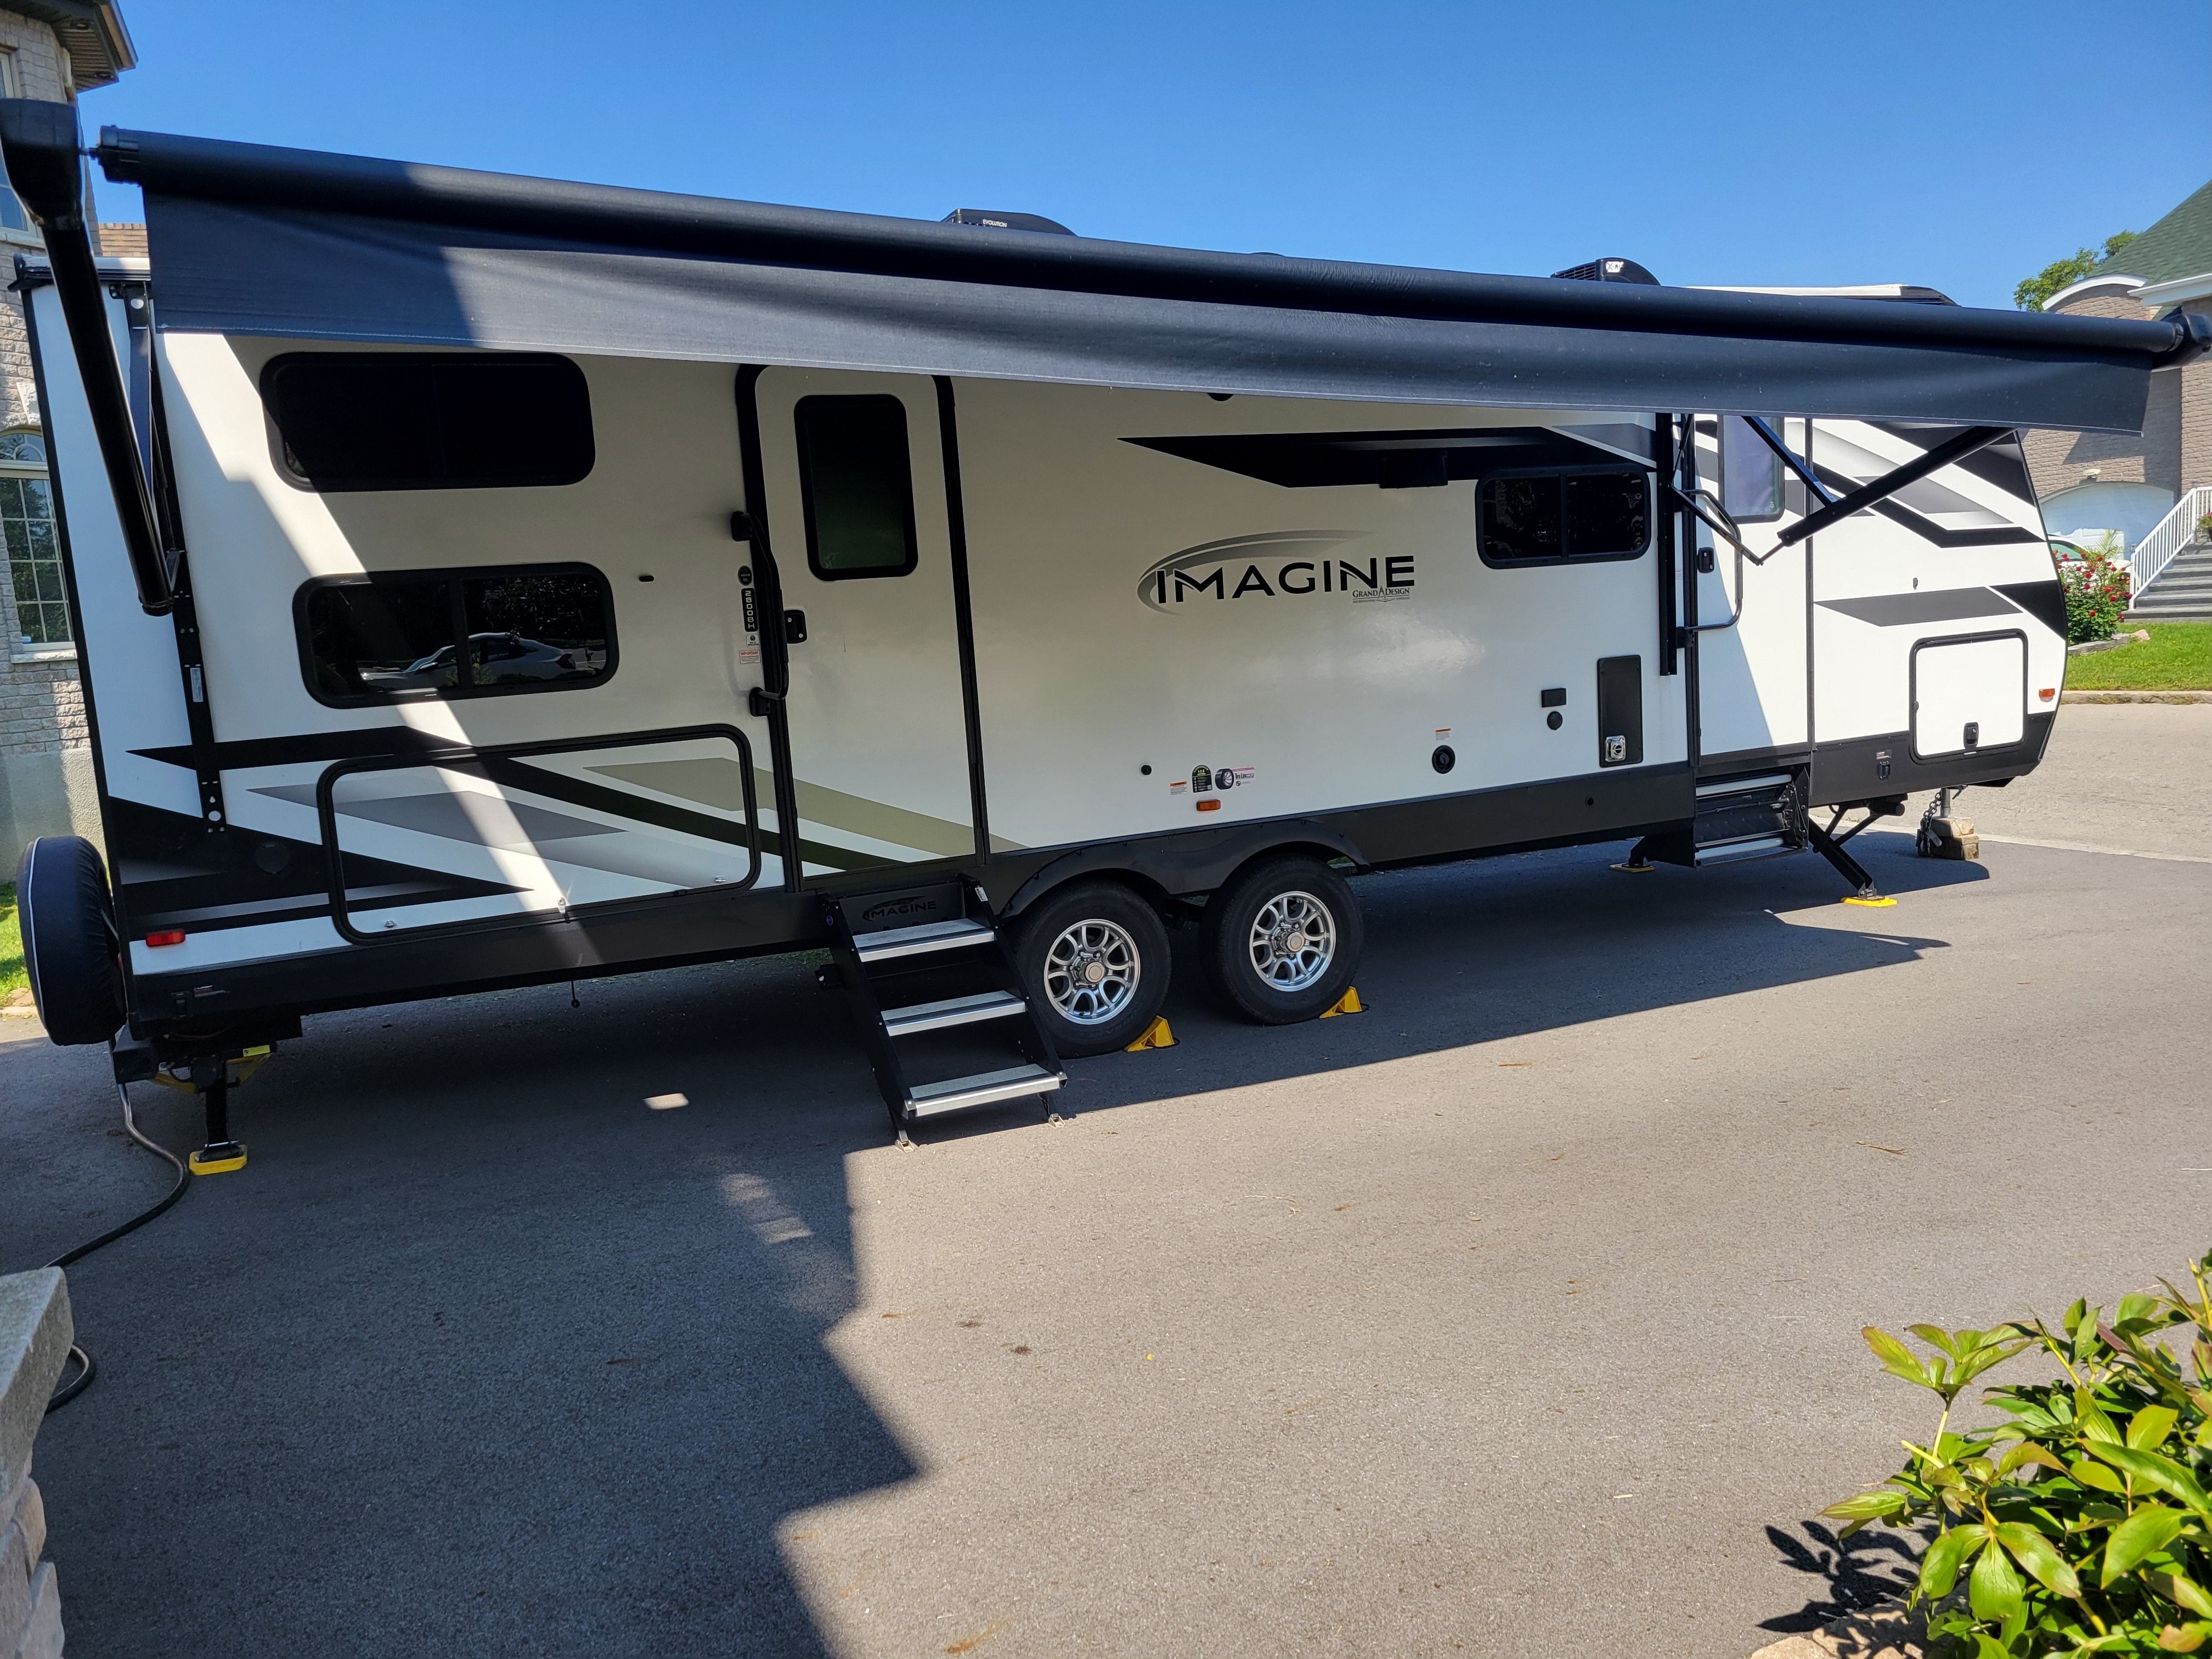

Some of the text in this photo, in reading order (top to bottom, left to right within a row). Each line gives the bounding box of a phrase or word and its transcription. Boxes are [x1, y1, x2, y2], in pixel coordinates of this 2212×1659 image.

[983, 219, 1007, 228] EVOLUTION
[1157, 556, 1414, 603] IMAGINE
[745, 590, 755, 629] 2800BH
[867, 900, 937, 919] IMAGINE
